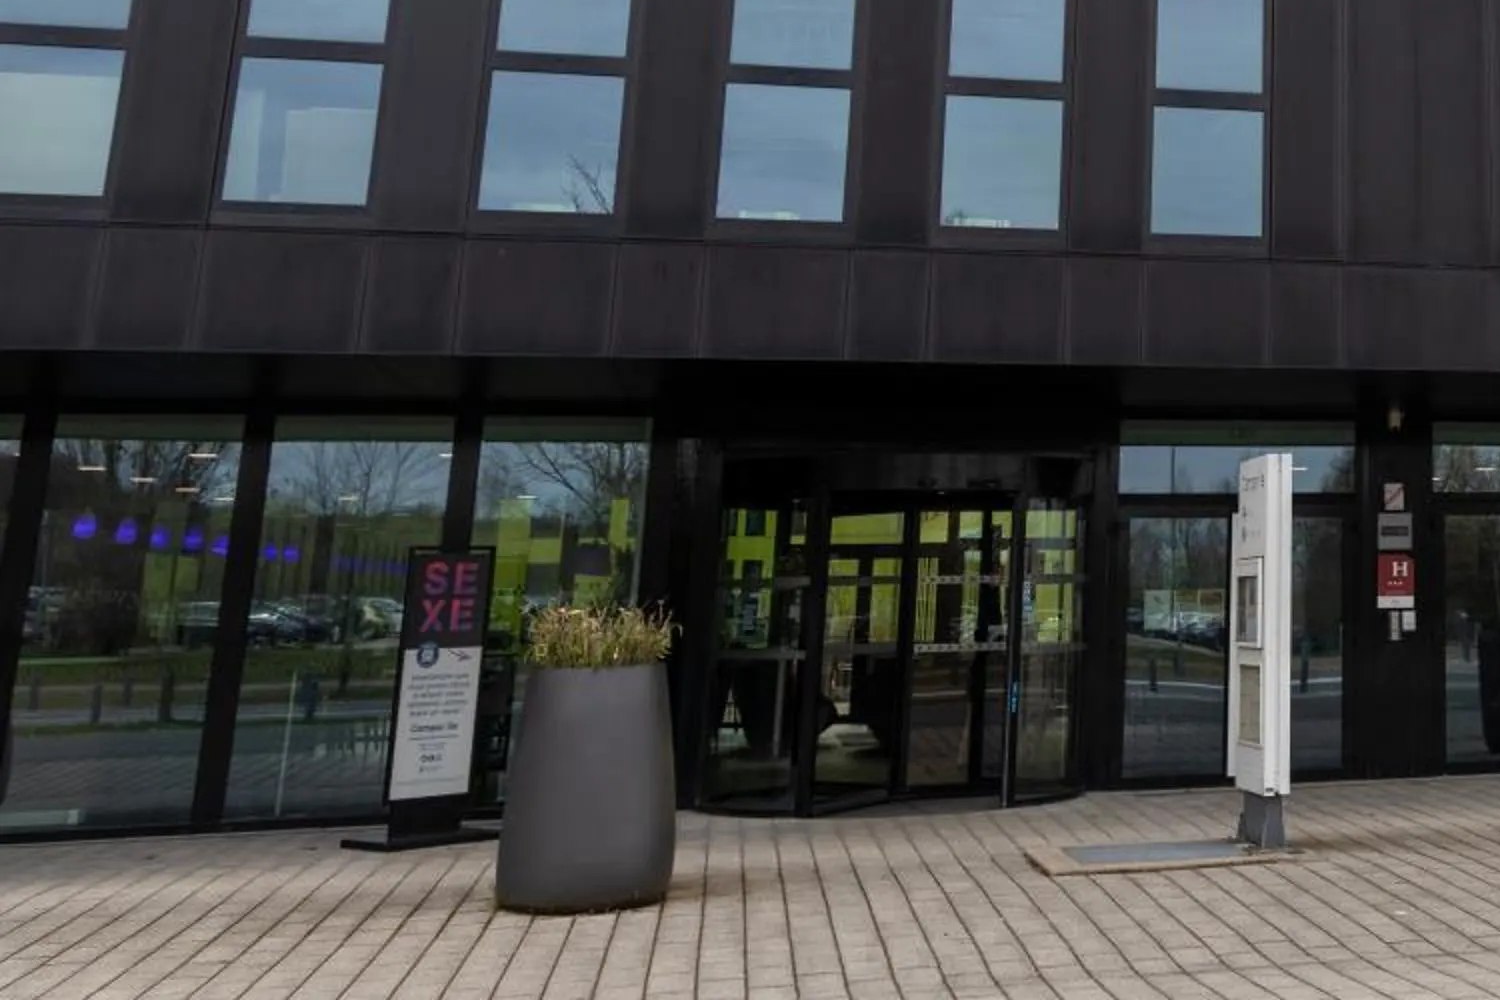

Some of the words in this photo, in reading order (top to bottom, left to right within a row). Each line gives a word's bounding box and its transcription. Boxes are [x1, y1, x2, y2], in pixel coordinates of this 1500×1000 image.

[424, 560, 481, 595] SE
[1391, 560, 1409, 577] H
[420, 599, 475, 633] XE
